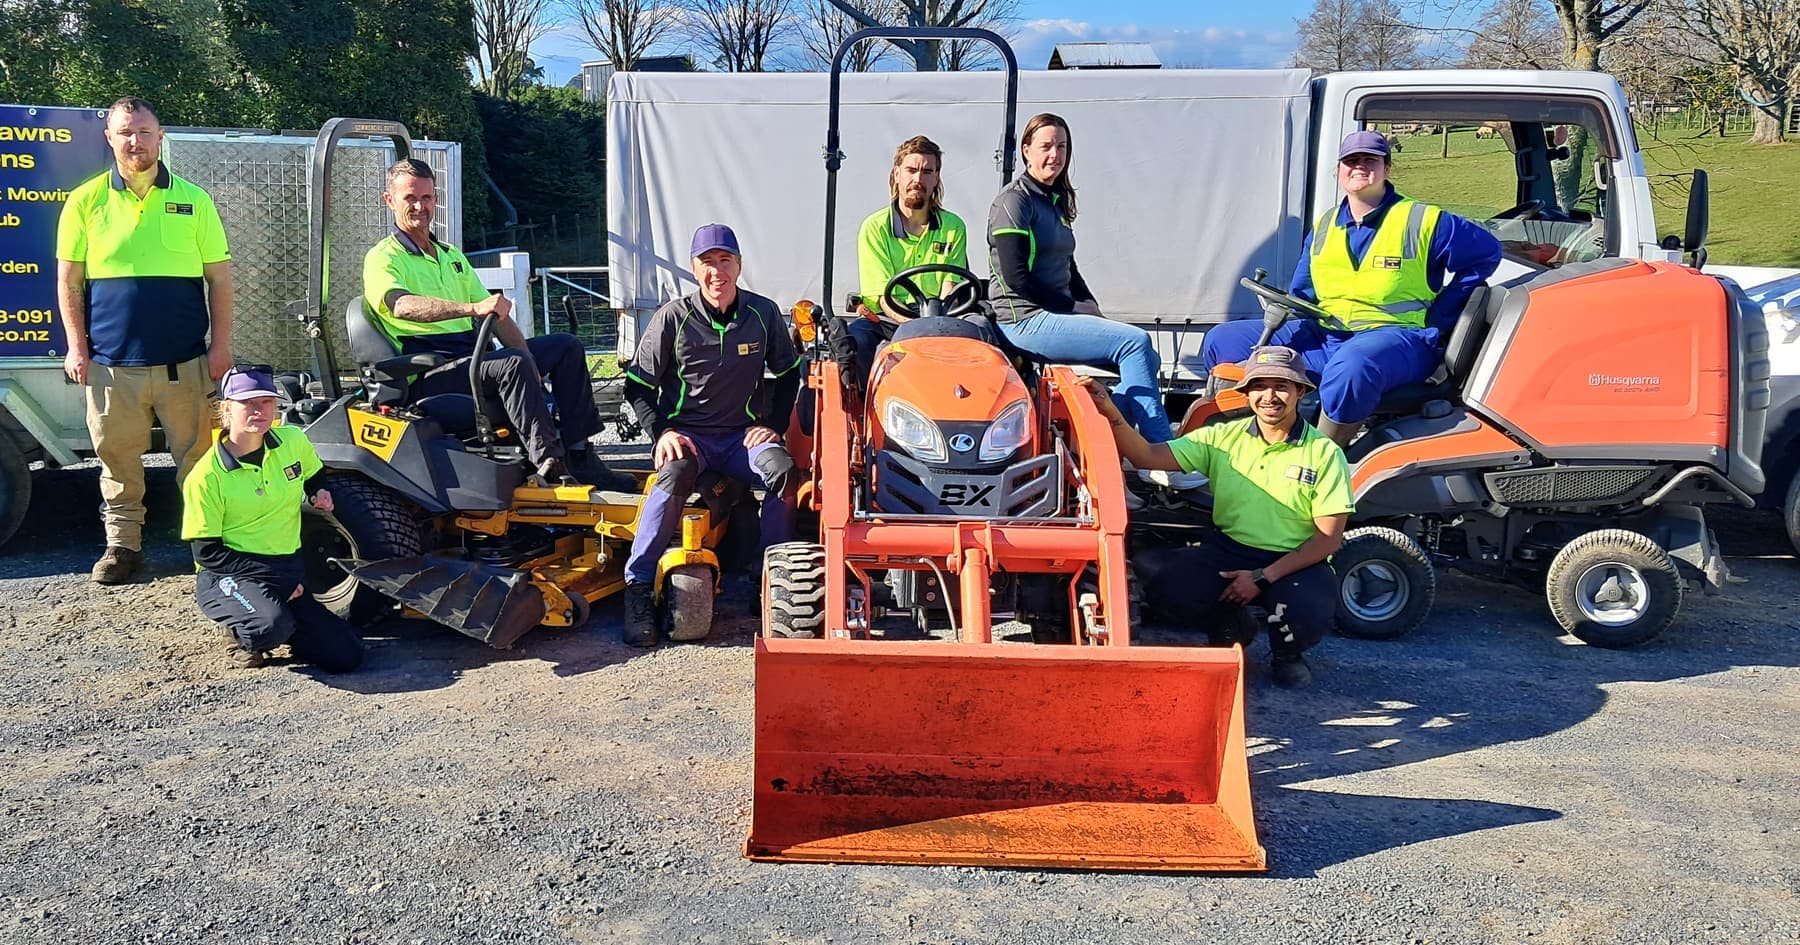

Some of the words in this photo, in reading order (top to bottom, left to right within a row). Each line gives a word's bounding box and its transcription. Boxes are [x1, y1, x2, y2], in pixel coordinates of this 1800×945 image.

[0, 260, 39, 273] den
[1600, 376, 1660, 386] Husqvarna
[939, 484, 996, 507] BX
